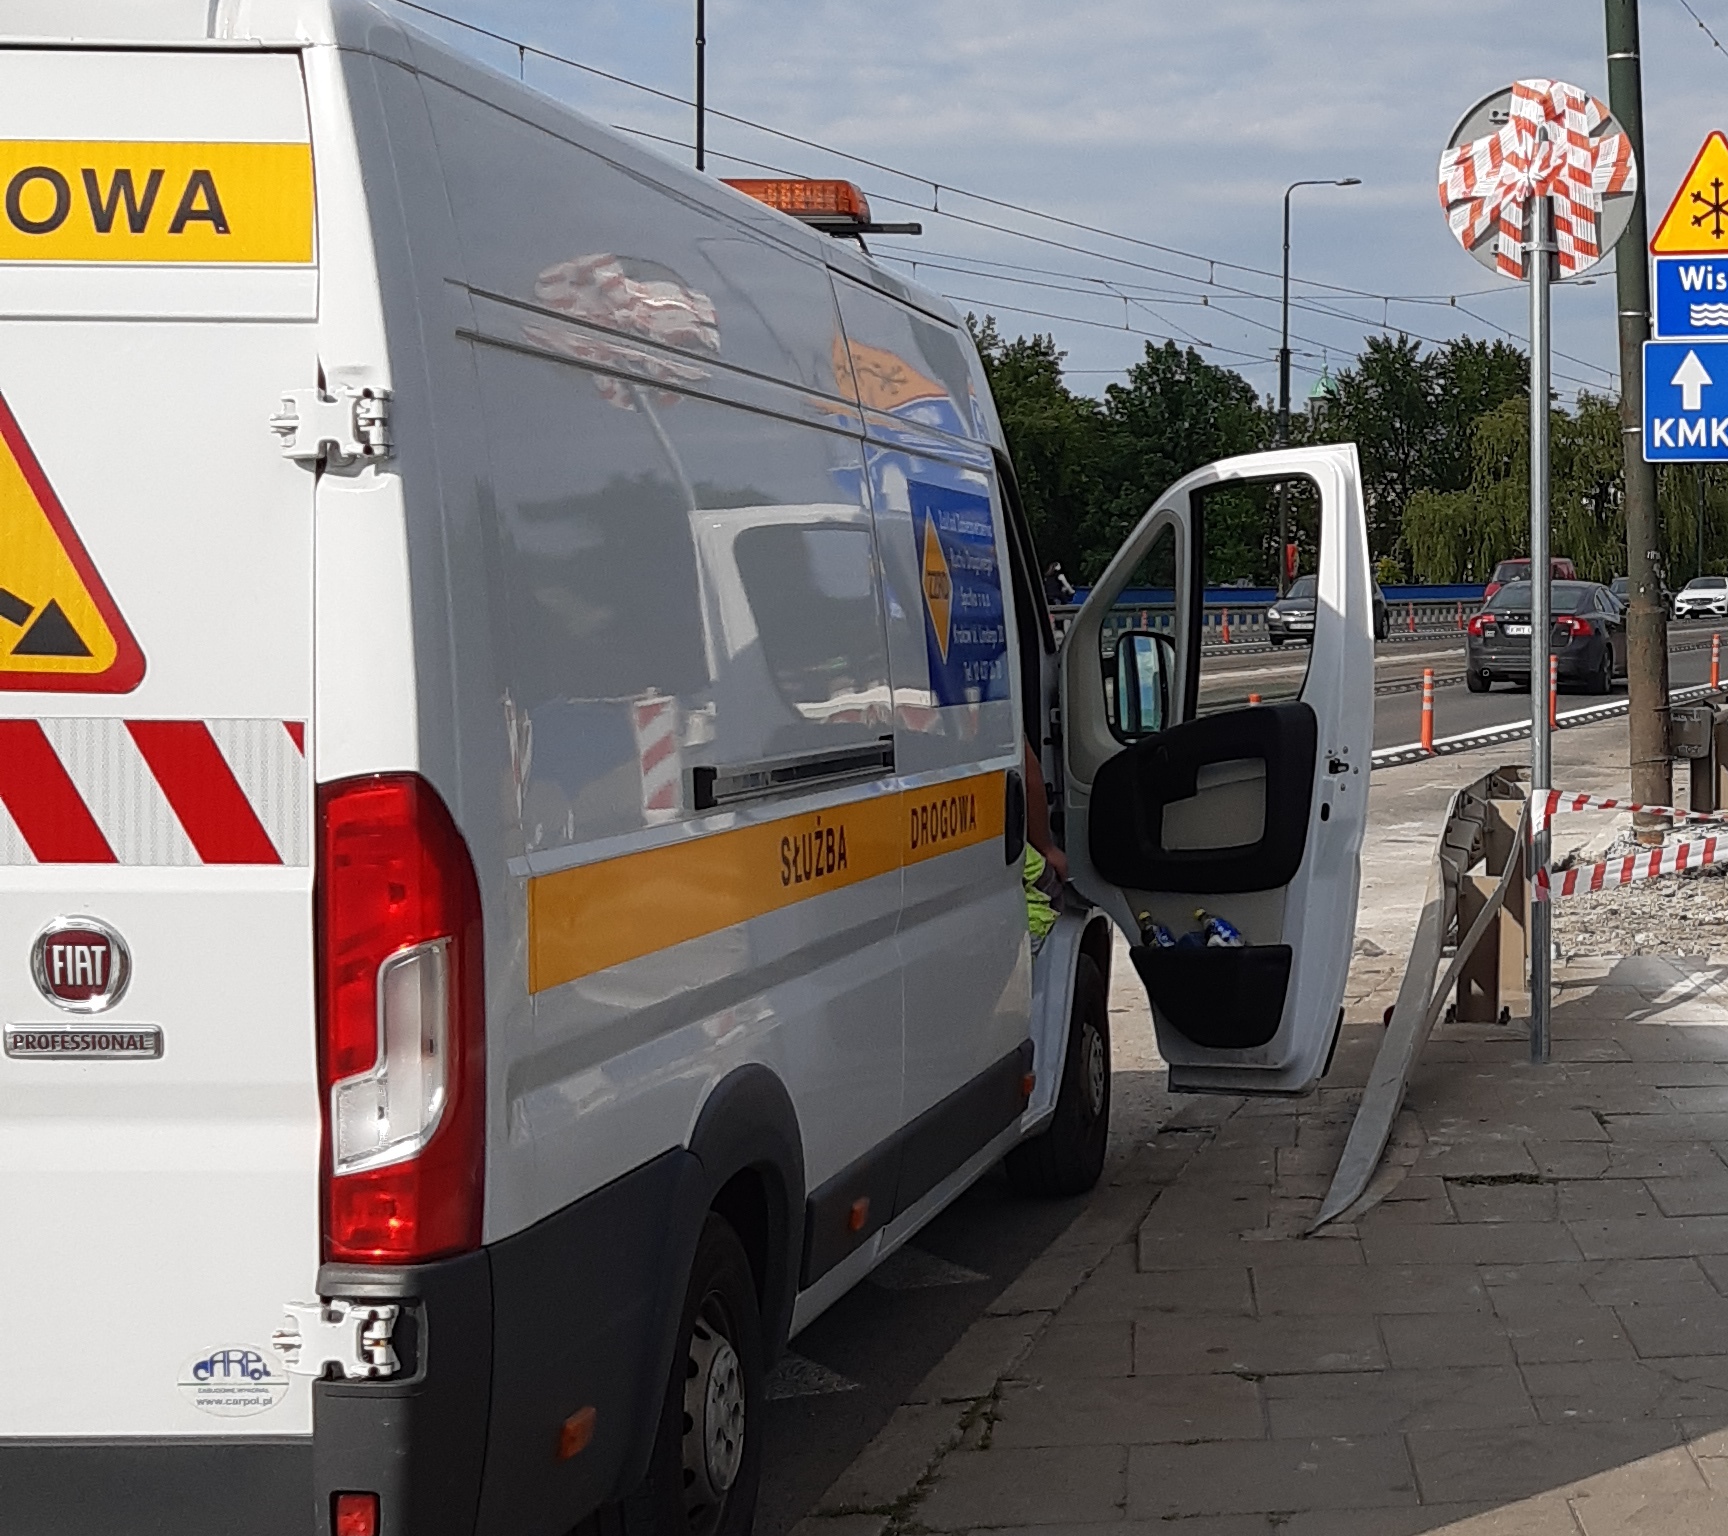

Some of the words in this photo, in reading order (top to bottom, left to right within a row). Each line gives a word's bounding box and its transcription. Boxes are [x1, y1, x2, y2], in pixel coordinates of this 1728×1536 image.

[5, 166, 231, 234] OWA
[780, 815, 848, 887] SŁUŻBA
[910, 794, 977, 849] DROGOWA
[52, 945, 106, 986] FIAT
[13, 1034, 149, 1051] PROFESSIONAL
[196, 1396, 273, 1407] www.carpol.pl
